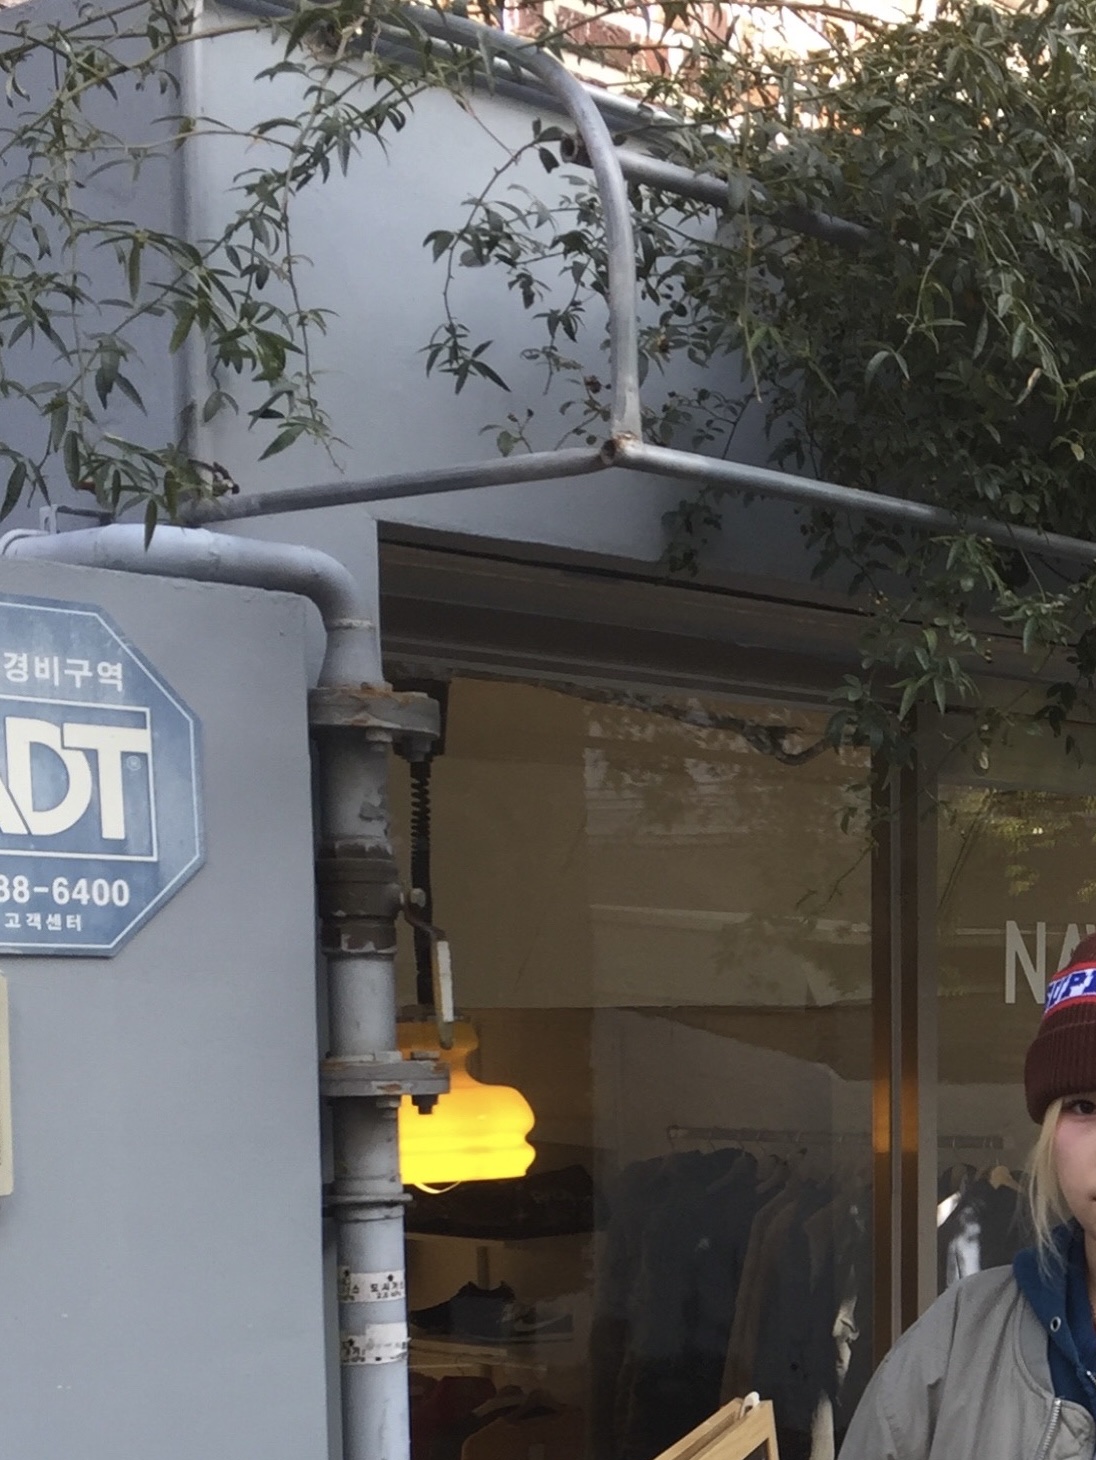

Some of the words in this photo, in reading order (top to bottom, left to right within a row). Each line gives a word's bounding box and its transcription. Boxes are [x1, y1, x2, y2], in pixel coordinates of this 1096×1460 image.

[3, 652, 123, 692] 경비구역
[4, 912, 82, 932] 고객센터
[1005, 920, 1096, 1004] NA
